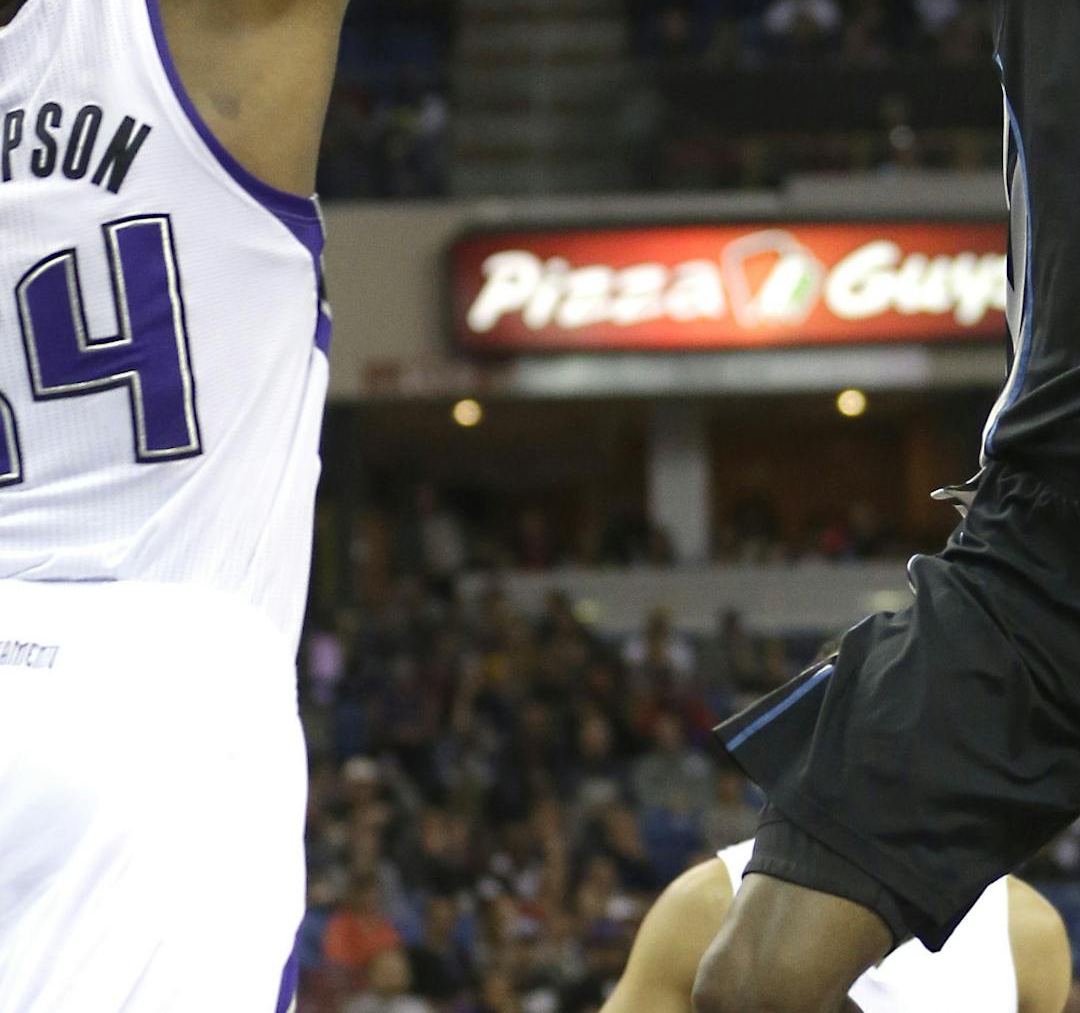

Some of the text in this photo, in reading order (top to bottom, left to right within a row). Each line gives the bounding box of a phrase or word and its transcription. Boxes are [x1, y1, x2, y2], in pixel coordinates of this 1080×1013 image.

[2, 101, 152, 194] PSON
[466, 249, 726, 333] Pizza
[0, 213, 203, 485] 4
